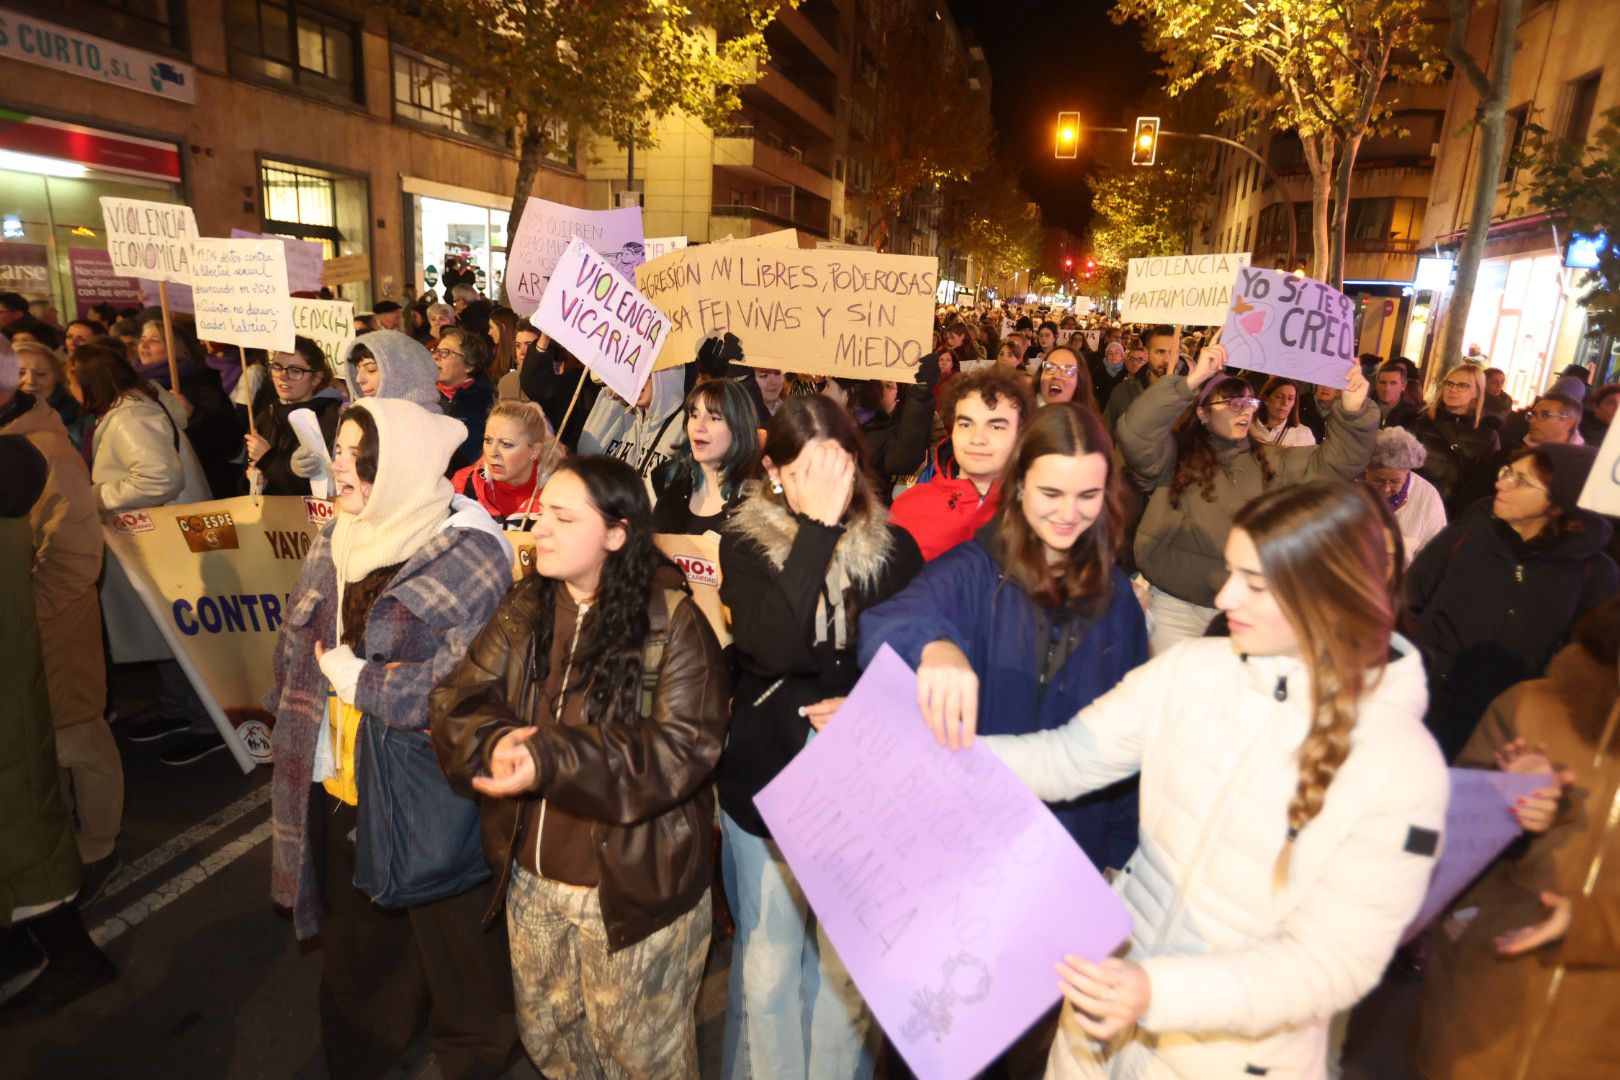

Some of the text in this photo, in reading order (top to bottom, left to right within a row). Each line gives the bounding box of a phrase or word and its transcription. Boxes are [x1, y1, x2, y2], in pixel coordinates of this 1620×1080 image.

[107, 203, 187, 239] VIOLENCIA
[112, 237, 190, 273] ECONÓMICA
[234, 263, 272, 277] sexual
[1134, 255, 1229, 278] VIOLENCIA
[640, 255, 701, 300] AGRESIÓN
[1278, 275, 1308, 306] SÍ
[576, 254, 662, 349] VIOLENCIA
[737, 297, 896, 339] VIVAS Y SIN
[562, 290, 641, 373] VICARIA
[834, 333, 921, 368] MIEDO
[1279, 307, 1351, 360] CREO
[172, 593, 291, 636] CONTR
[850, 705, 1013, 901] QUE BUSCAMOS
[787, 779, 919, 959] VENGANZA
[937, 891, 990, 944] NO
